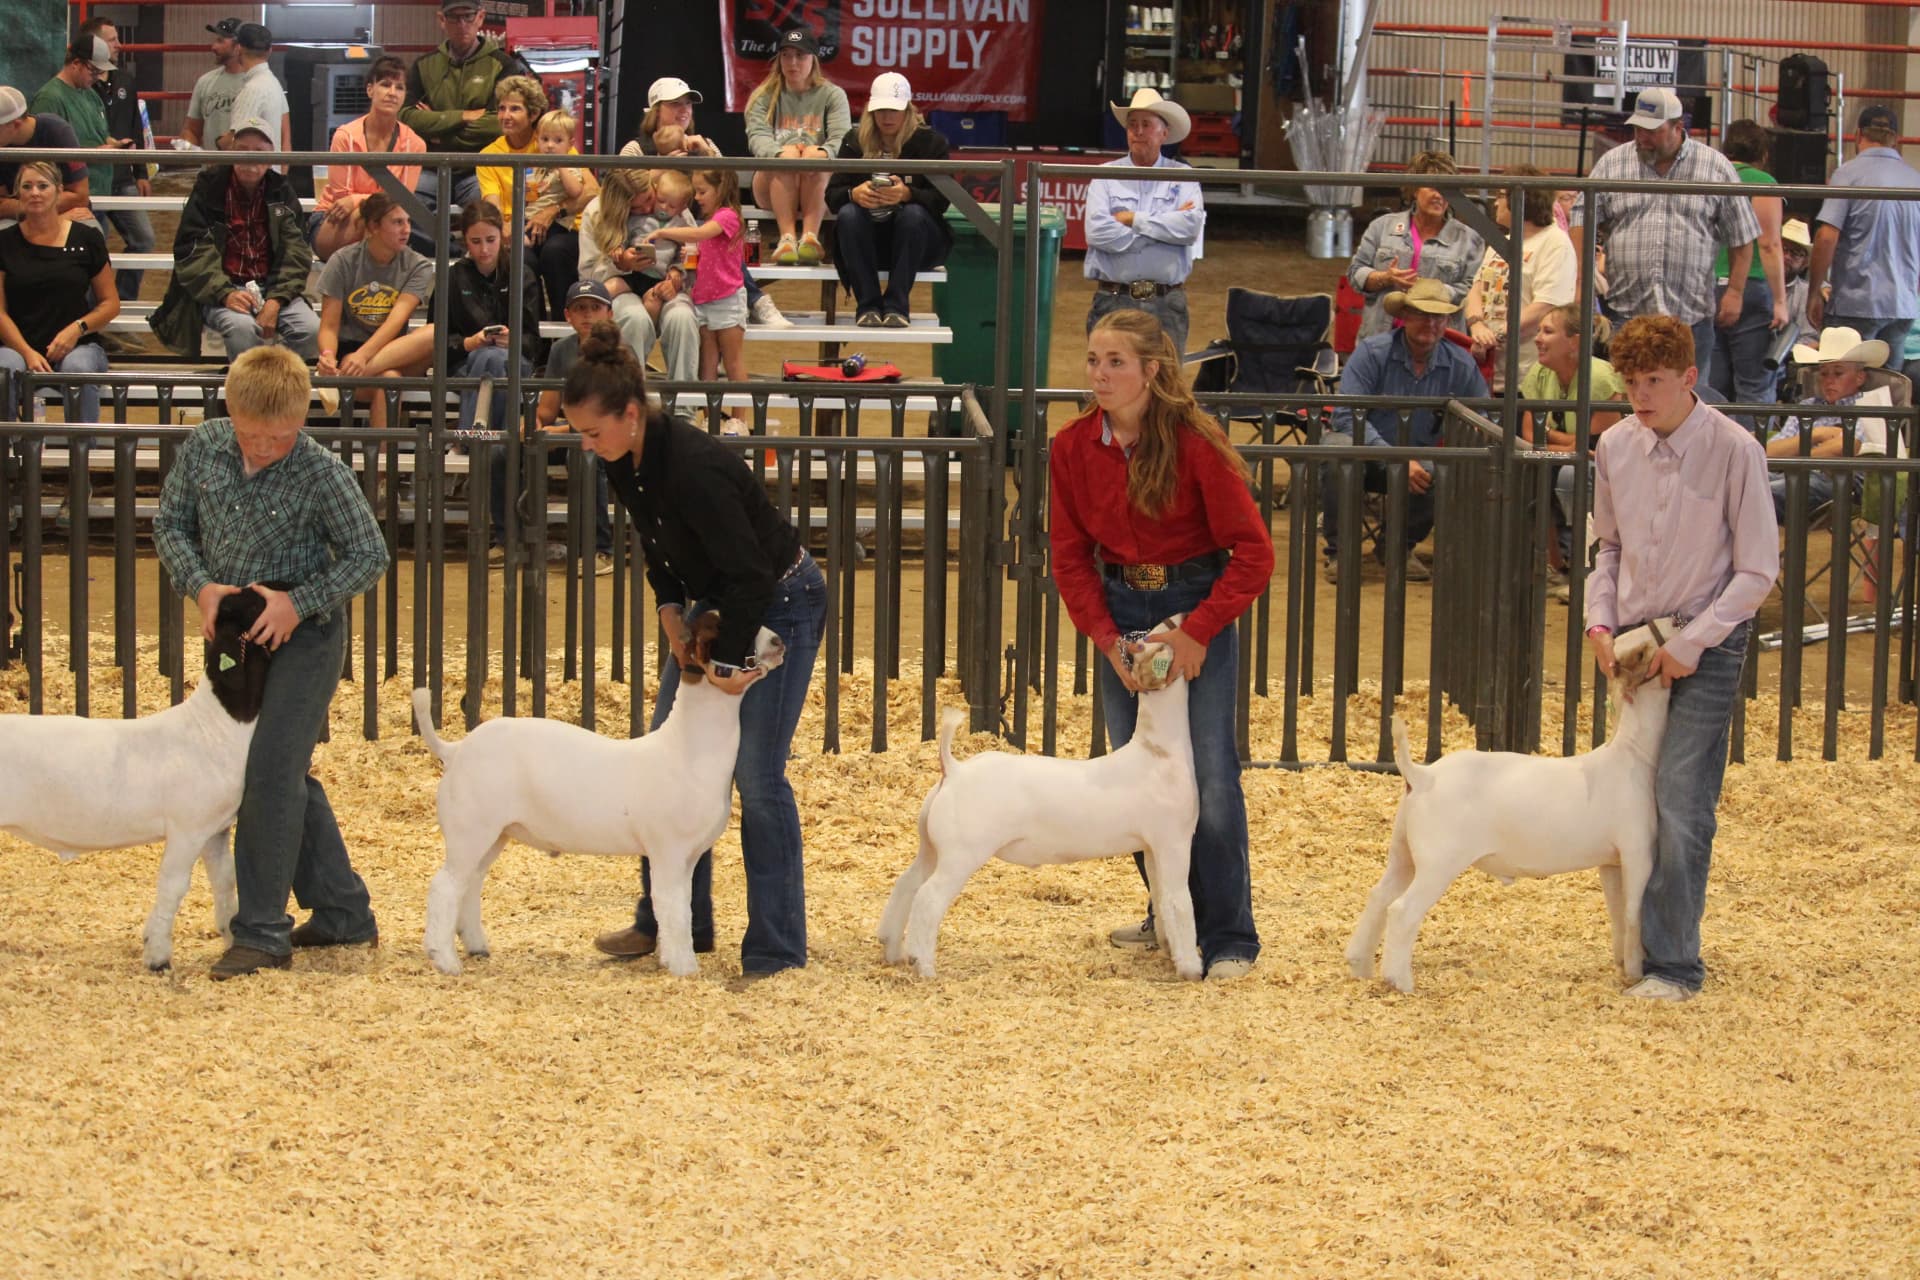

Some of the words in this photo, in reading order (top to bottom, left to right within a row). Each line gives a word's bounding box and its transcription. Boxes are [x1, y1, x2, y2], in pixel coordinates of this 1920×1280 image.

[740, 39, 762, 52] The
[851, 26, 992, 69] SUPPLY
[1601, 46, 1671, 69] FROW
[1021, 181, 1089, 201] SLLIV
